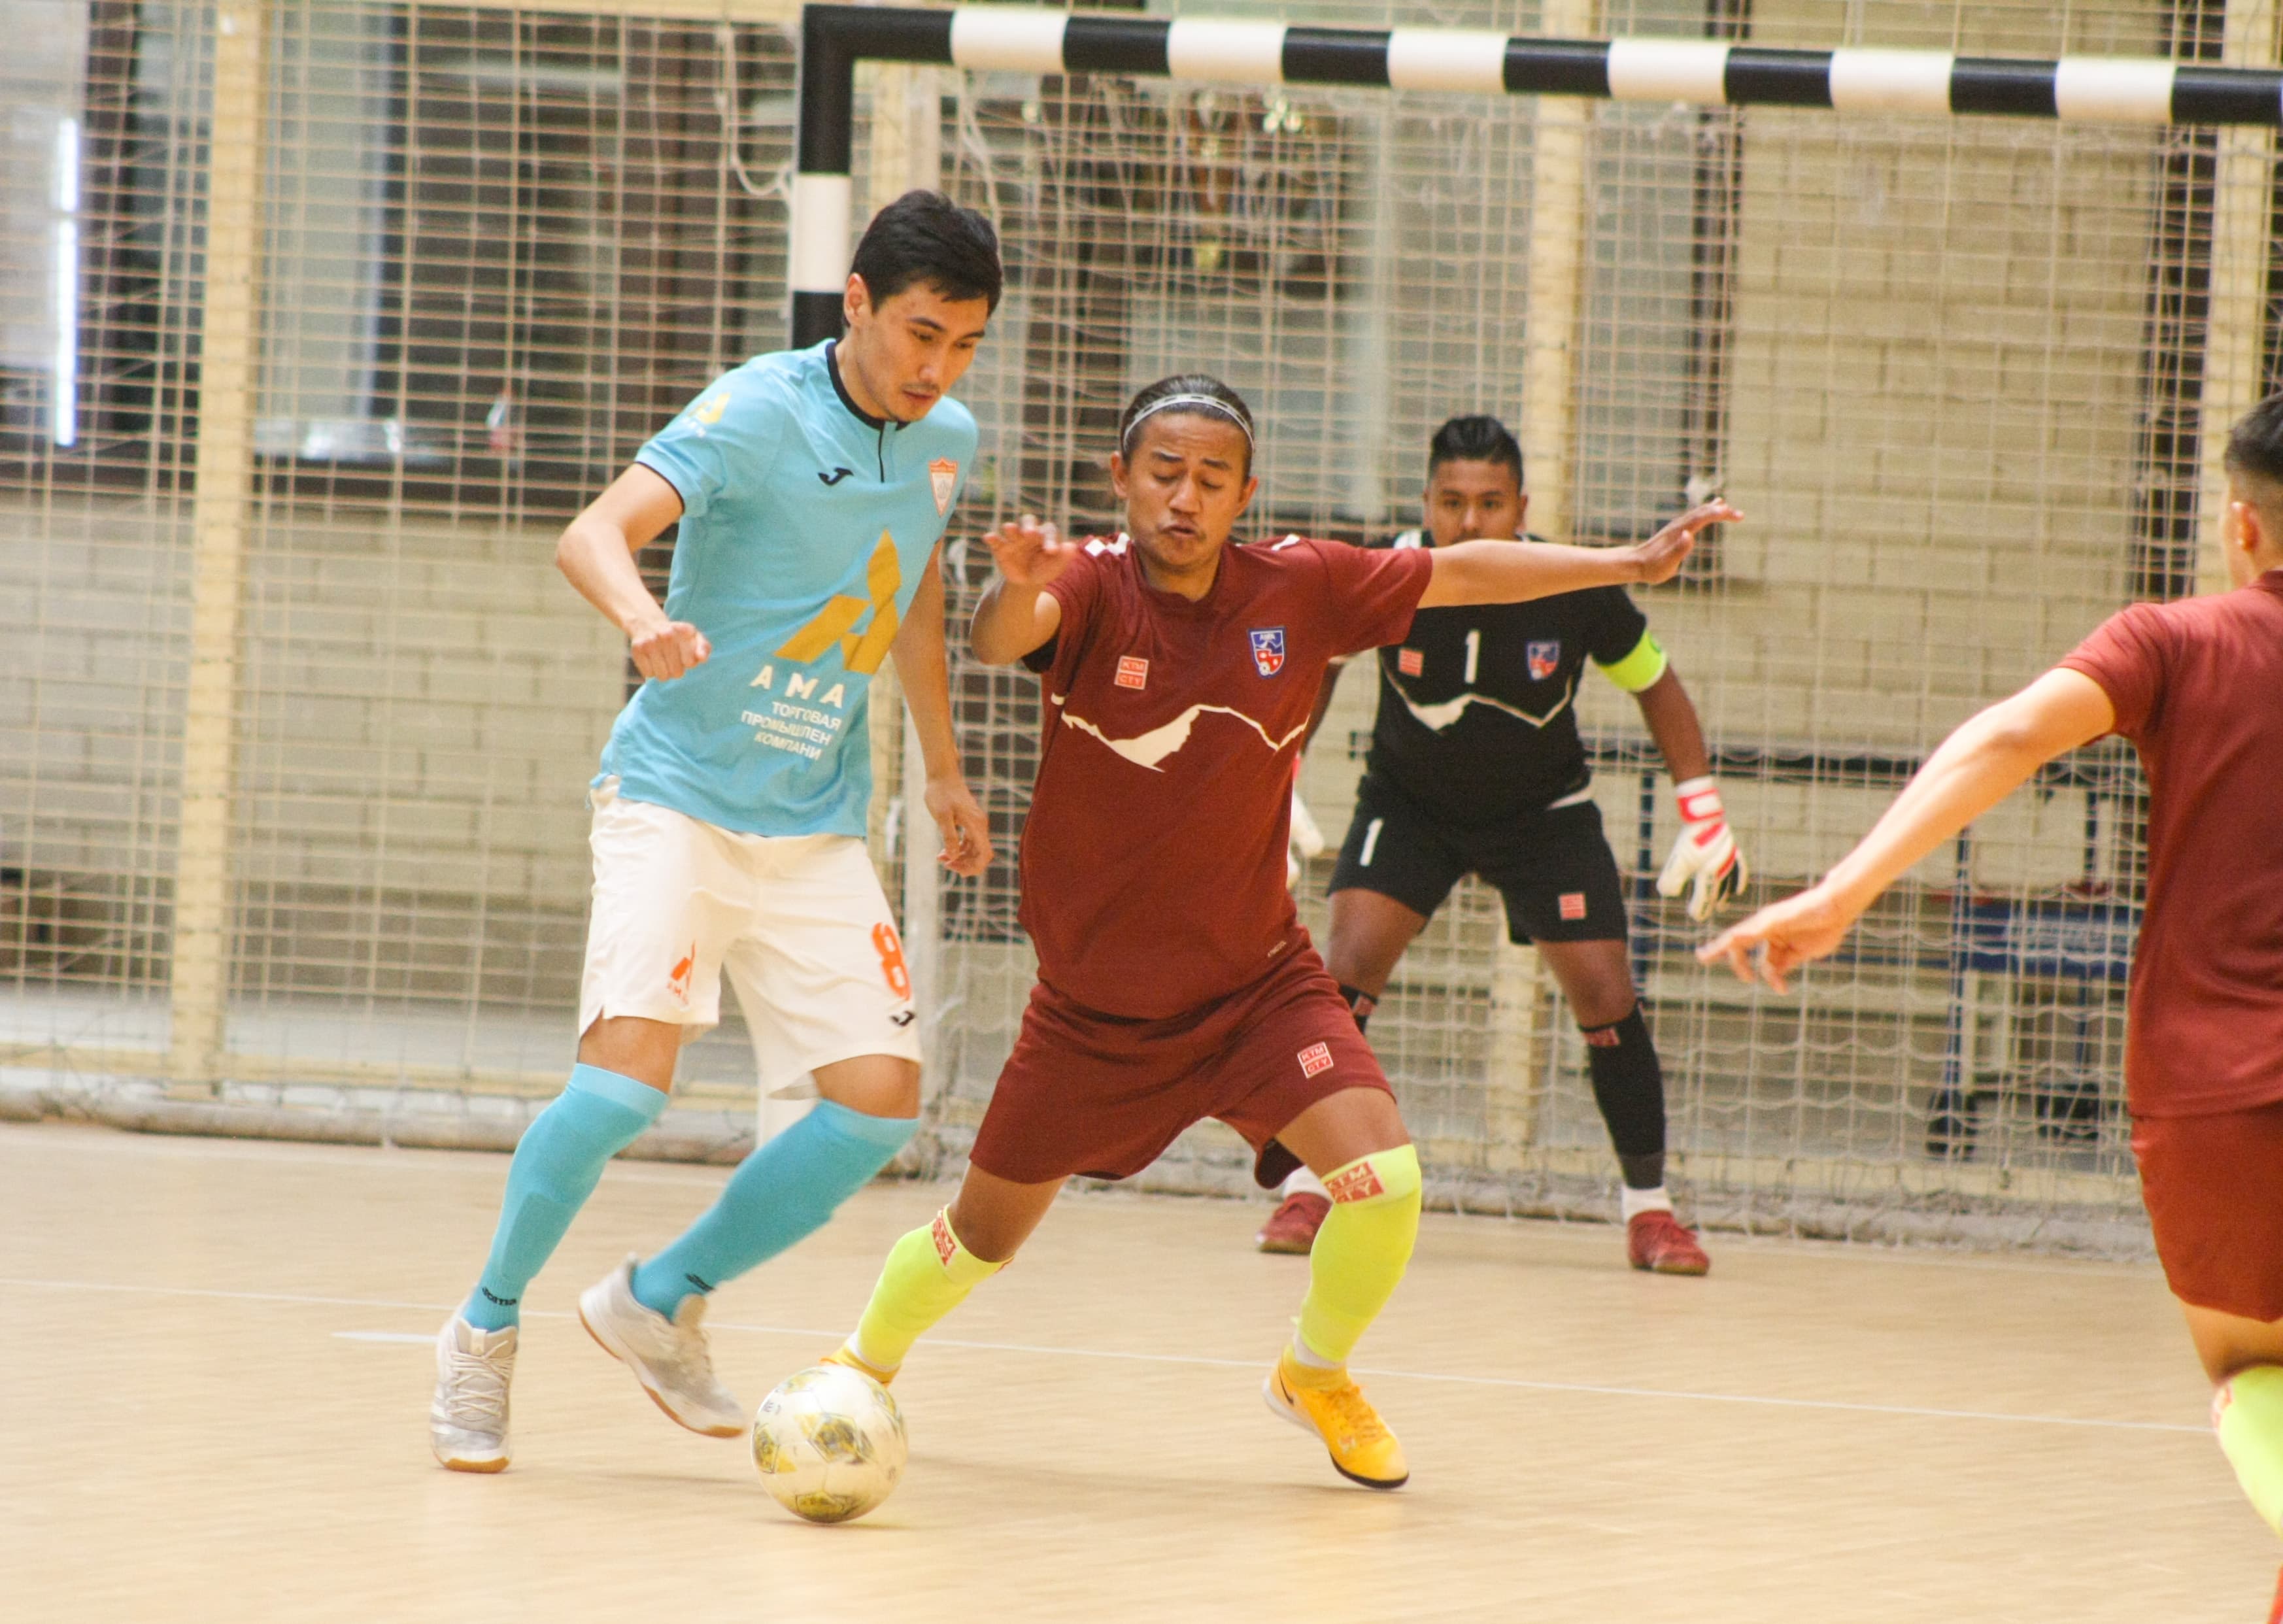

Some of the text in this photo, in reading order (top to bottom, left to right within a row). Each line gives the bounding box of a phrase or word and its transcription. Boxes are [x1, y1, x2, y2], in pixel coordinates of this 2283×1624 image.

[1465, 629, 1480, 684] 1
[772, 701, 842, 730] ТОРГОВАЯ
[1360, 818, 1383, 866] 1
[871, 922, 911, 1001] 8
[1300, 1045, 1326, 1062] KTM
[1325, 1166, 1368, 1190] KTM
